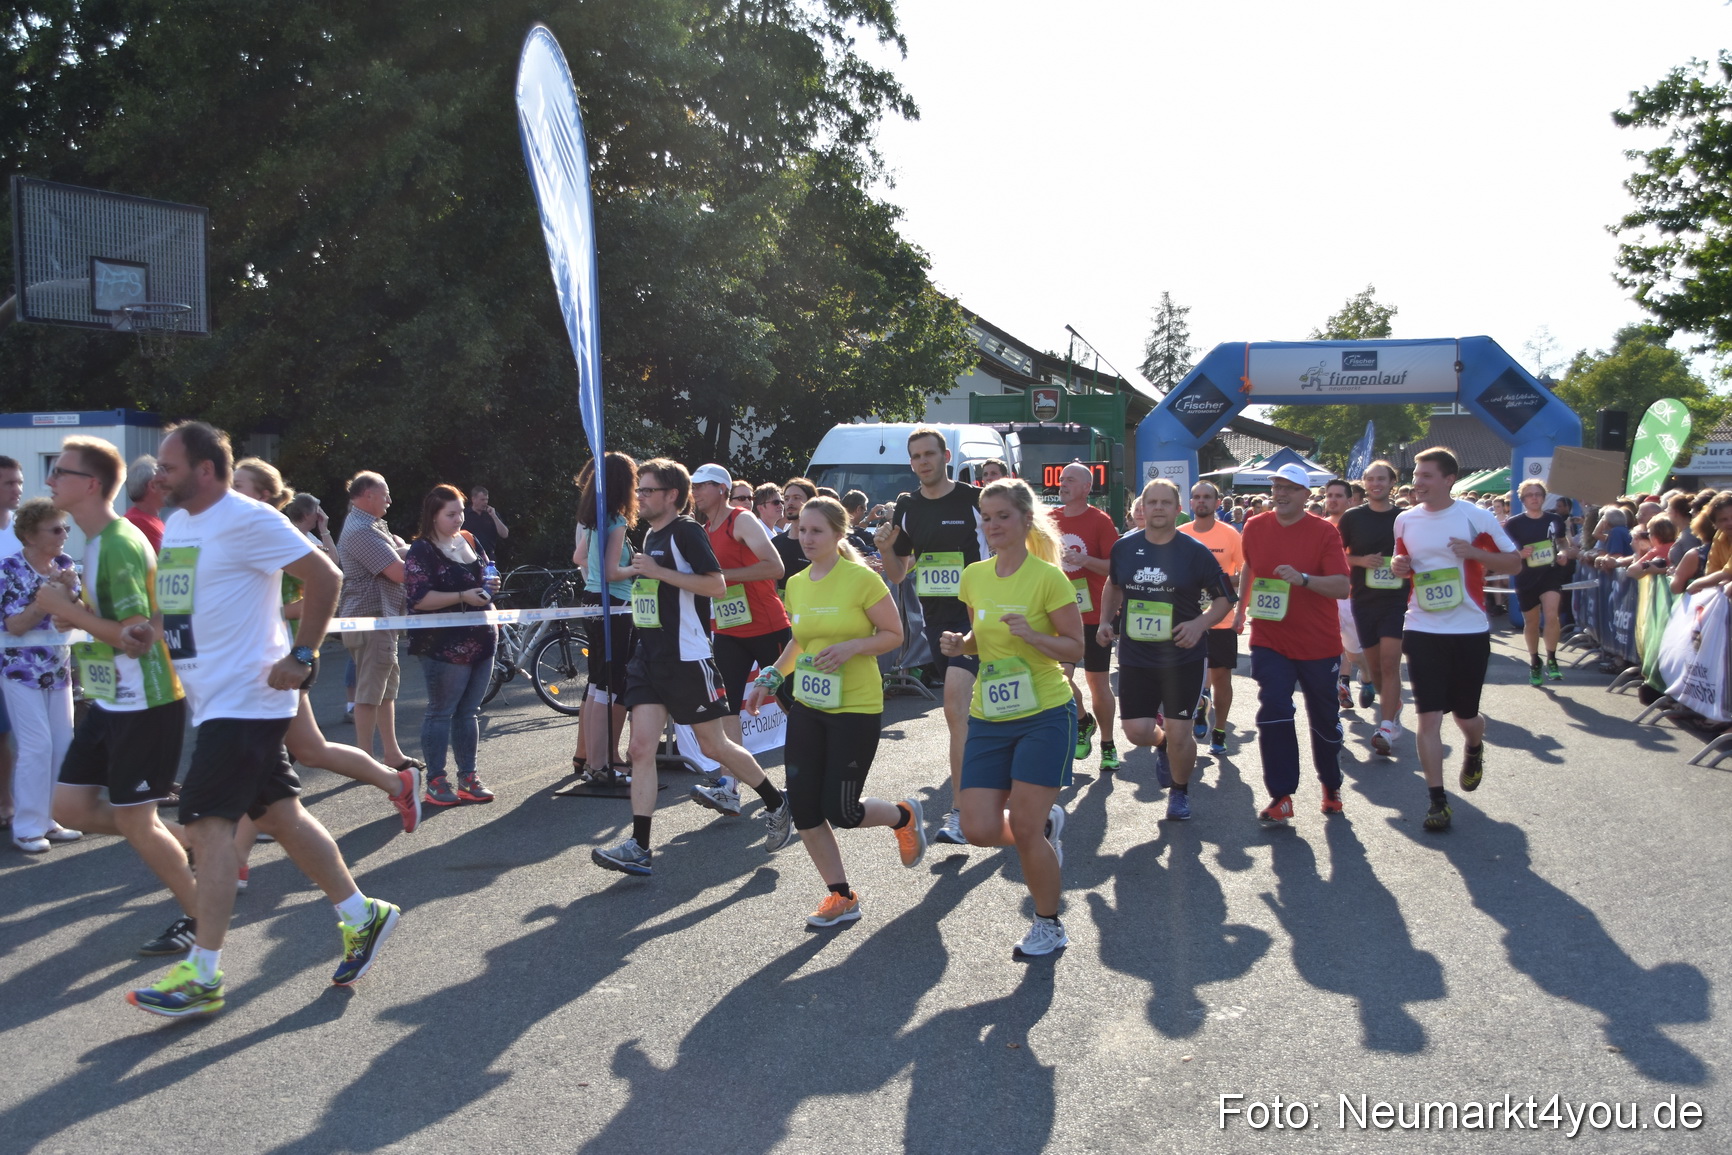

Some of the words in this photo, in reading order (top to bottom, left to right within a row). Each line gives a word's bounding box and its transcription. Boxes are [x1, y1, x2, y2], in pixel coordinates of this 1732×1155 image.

[1328, 370, 1408, 386] firmenlauf
[1183, 400, 1224, 410] Fischer
[1658, 434, 1680, 459] AOK
[1631, 452, 1658, 482] AOK
[922, 569, 960, 584] 1080
[1373, 569, 1396, 581] 823
[158, 574, 190, 595] 1163
[1425, 584, 1453, 601] 830
[634, 598, 656, 614] 1078
[716, 600, 746, 618] 1393
[1257, 594, 1280, 609] 828
[1136, 617, 1161, 632] 171
[88, 664, 112, 685] 985
[802, 675, 831, 696] 668
[988, 680, 1020, 703] 667
